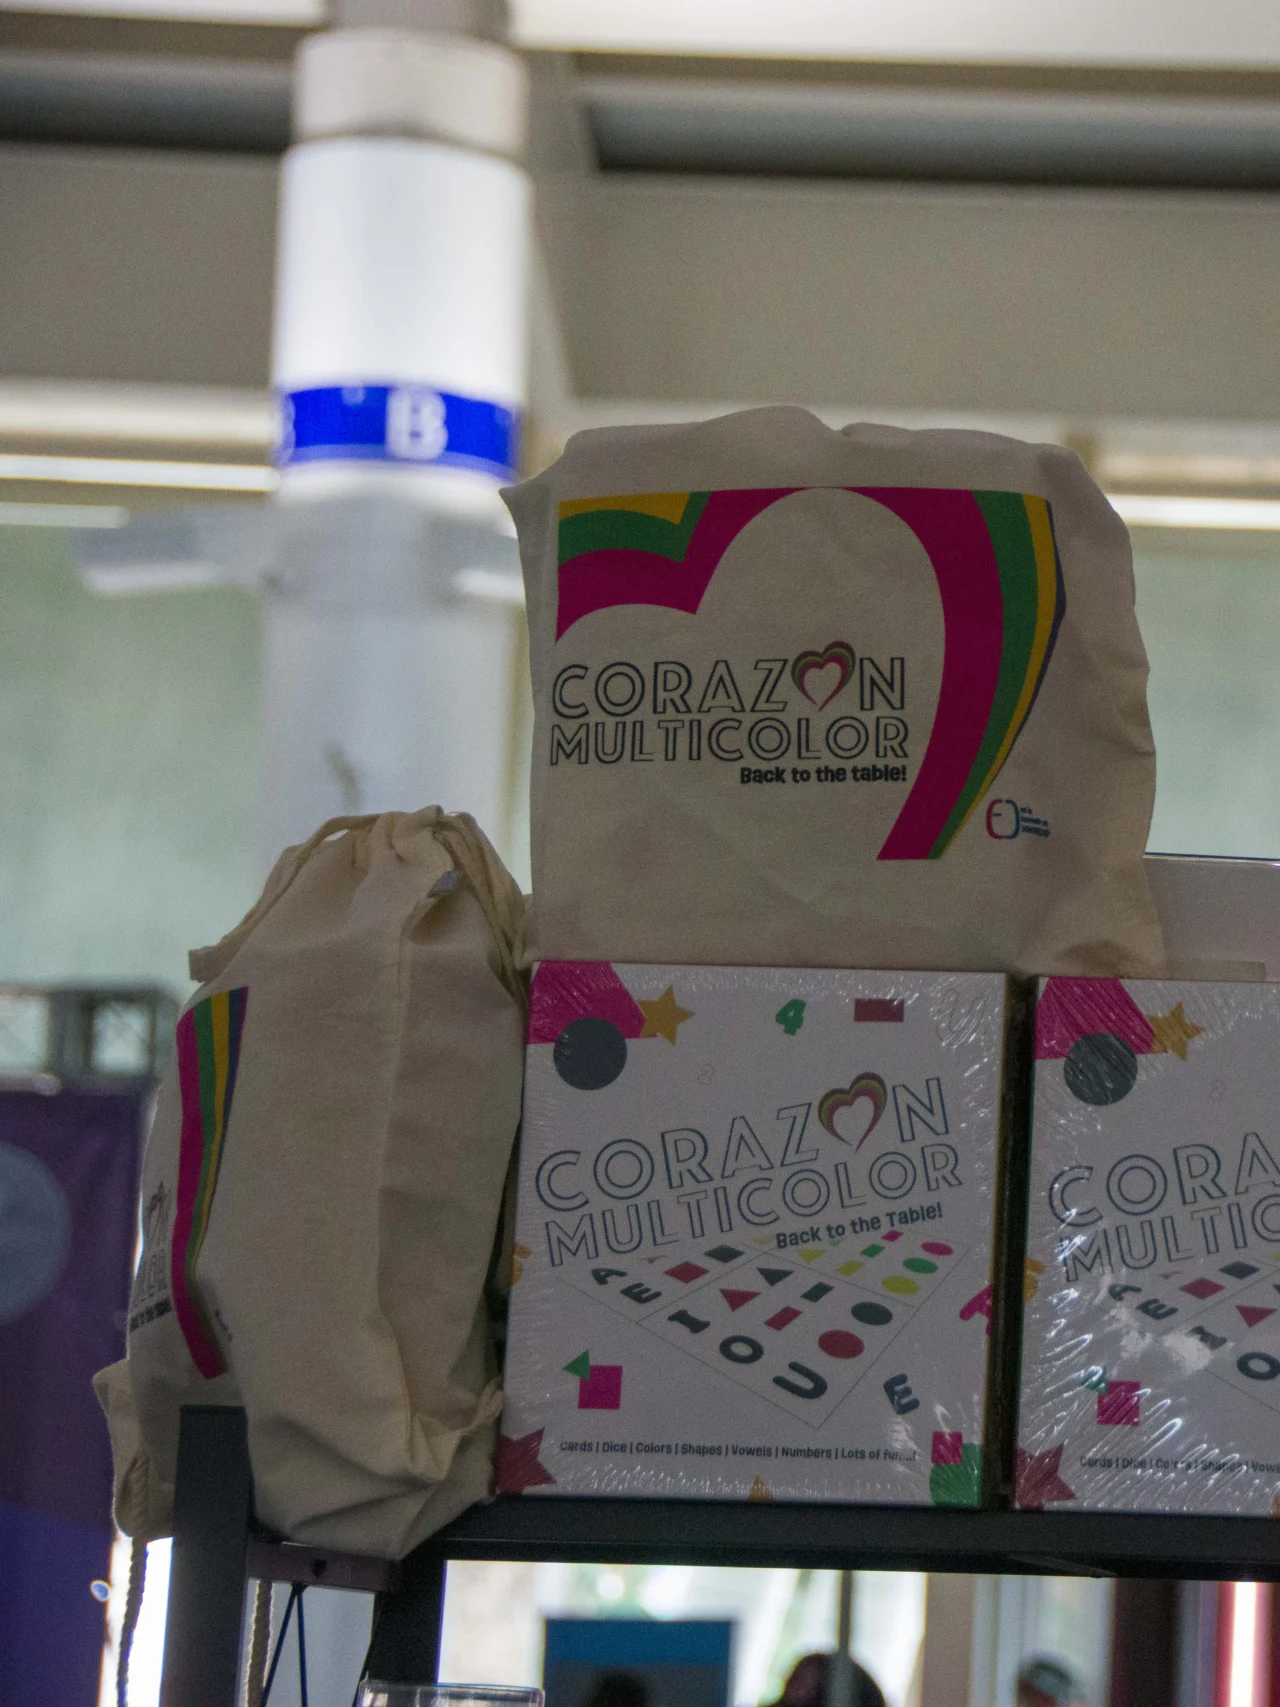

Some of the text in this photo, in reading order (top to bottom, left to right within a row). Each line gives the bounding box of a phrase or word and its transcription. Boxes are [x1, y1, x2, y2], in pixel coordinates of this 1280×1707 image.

[386, 386, 448, 461] B
[550, 716, 909, 766] MULTICOLOR
[740, 764, 907, 784] Back to the table!
[776, 999, 806, 1036] 4
[545, 1143, 963, 1267] MULTICOLOR
[776, 1201, 943, 1249] Back to the Table!
[560, 1441, 592, 1453] Cards
[602, 1441, 626, 1453] Dice
[636, 1442, 672, 1454] Colors
[681, 1443, 722, 1457] Shapes
[732, 1444, 772, 1457] Vowels
[782, 1446, 832, 1459] Numbers
[841, 1448, 865, 1460] Lots
[869, 1449, 880, 1460] of
